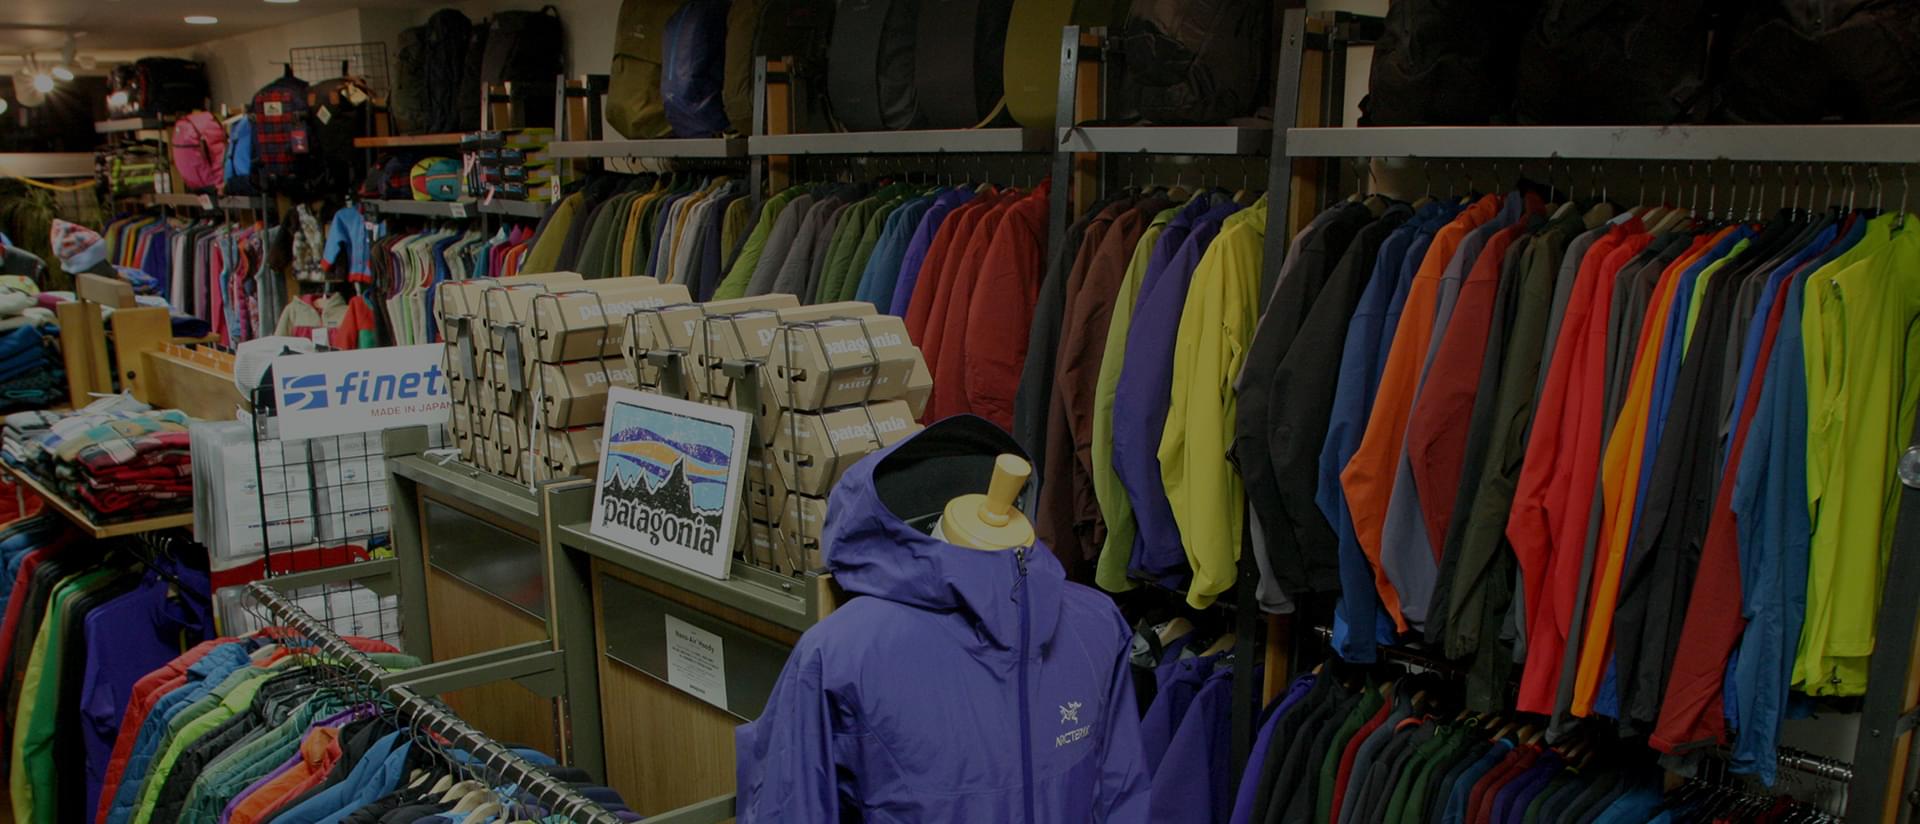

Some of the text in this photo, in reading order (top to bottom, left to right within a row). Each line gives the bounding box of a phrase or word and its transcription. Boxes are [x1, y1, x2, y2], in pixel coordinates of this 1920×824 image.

[335, 364, 448, 405] finet
[371, 405, 400, 417] MADE
[404, 405, 416, 414] IN
[602, 497, 717, 556] patagonia
